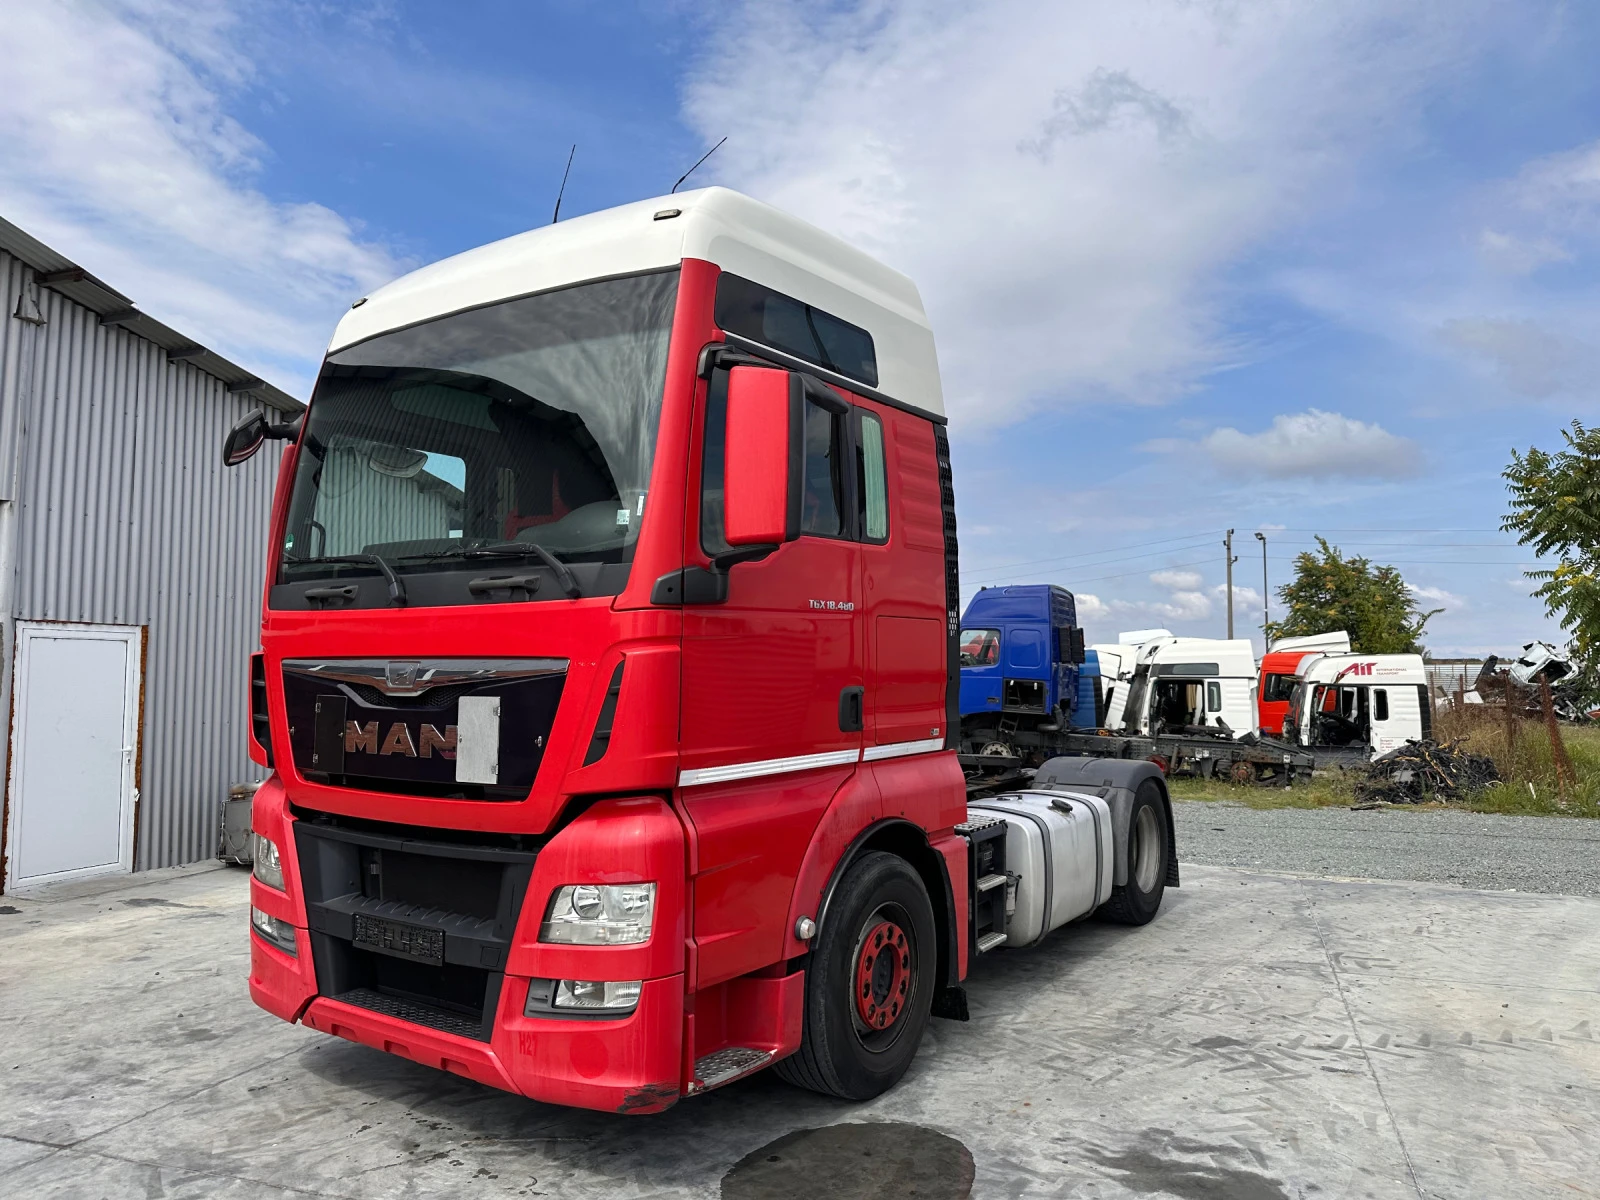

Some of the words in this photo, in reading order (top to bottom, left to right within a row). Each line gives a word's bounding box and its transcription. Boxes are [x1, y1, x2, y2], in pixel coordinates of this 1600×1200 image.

[808, 599, 826, 609] TGX
[826, 600, 854, 611] 18.480
[344, 719, 458, 761] MAN
